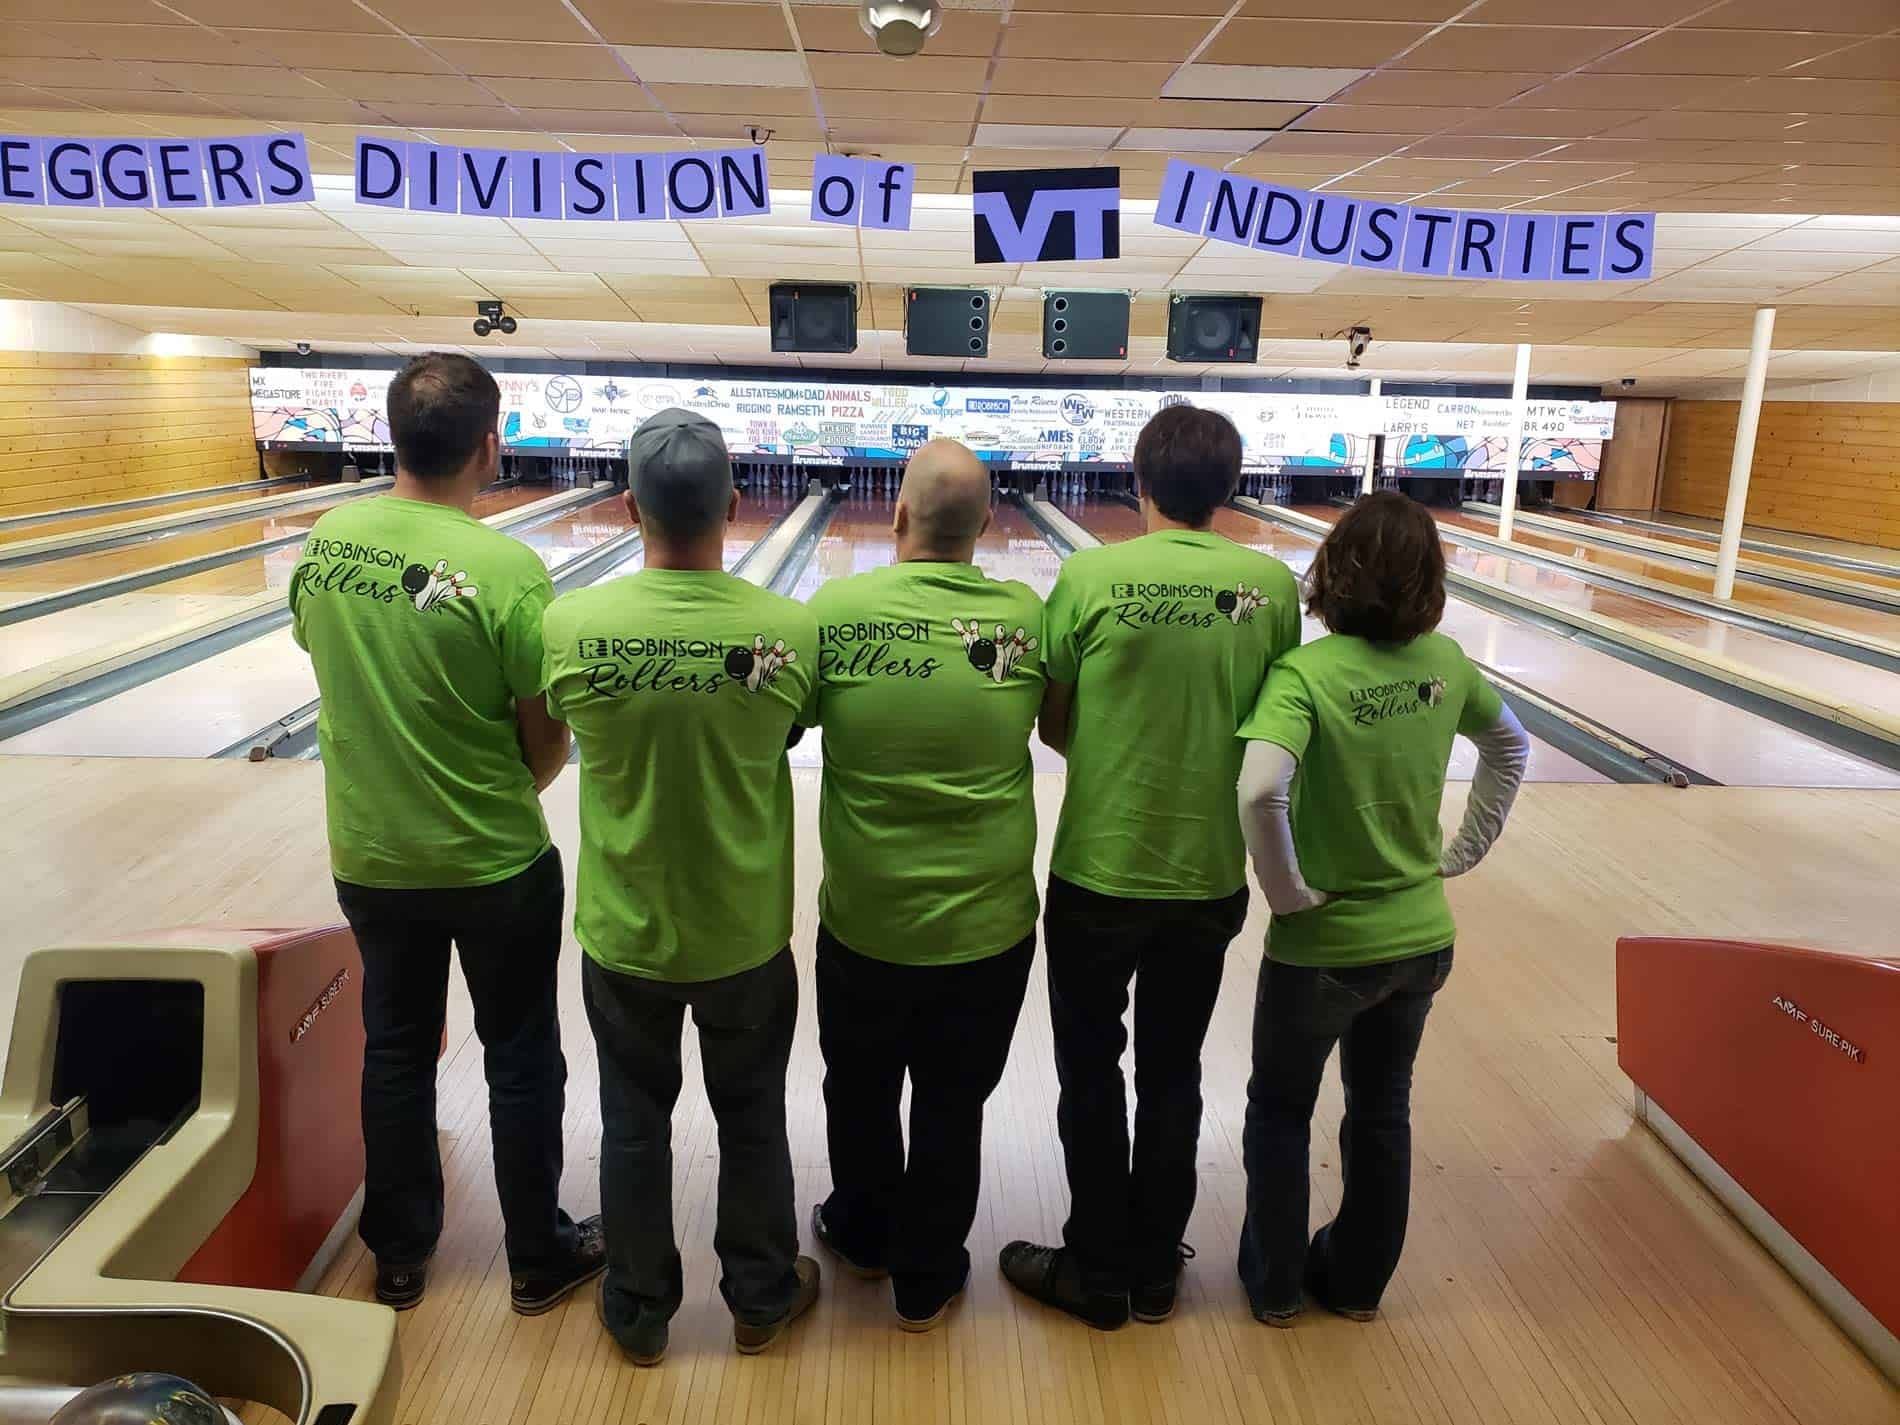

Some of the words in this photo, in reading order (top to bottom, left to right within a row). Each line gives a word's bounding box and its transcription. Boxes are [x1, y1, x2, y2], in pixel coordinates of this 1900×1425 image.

[1, 139, 303, 202] EGGERS
[360, 144, 765, 215] DIVISION
[818, 165, 905, 218] of
[1175, 170, 1645, 274] INDUSTRIES
[825, 389, 871, 402] ANIMALS
[736, 402, 772, 414] RIGGING
[777, 403, 825, 416] RAMSETH
[832, 406, 865, 418] PIZZA
[1385, 398, 1430, 410] LEGEND
[1526, 406, 1567, 417] MTWC
[1523, 421, 1538, 431] BR
[1541, 421, 1565, 432] 490
[569, 447, 622, 458] Brunswick
[792, 455, 844, 466] Brunswick
[1011, 460, 1063, 471] Brunswick
[1583, 472, 1595, 481] 12
[321, 539, 406, 570] ROBINSON
[297, 561, 404, 603] Rollers
[1137, 583, 1214, 603] ROBINSON
[1114, 600, 1222, 630] Rollers
[828, 621, 930, 650] ROBINSON
[612, 638, 724, 664] ROBINSON
[818, 643, 944, 684] Rollers
[580, 658, 729, 698] Rollers
[1352, 696, 1418, 726] Rollers
[1772, 996, 1808, 1023] AMF
